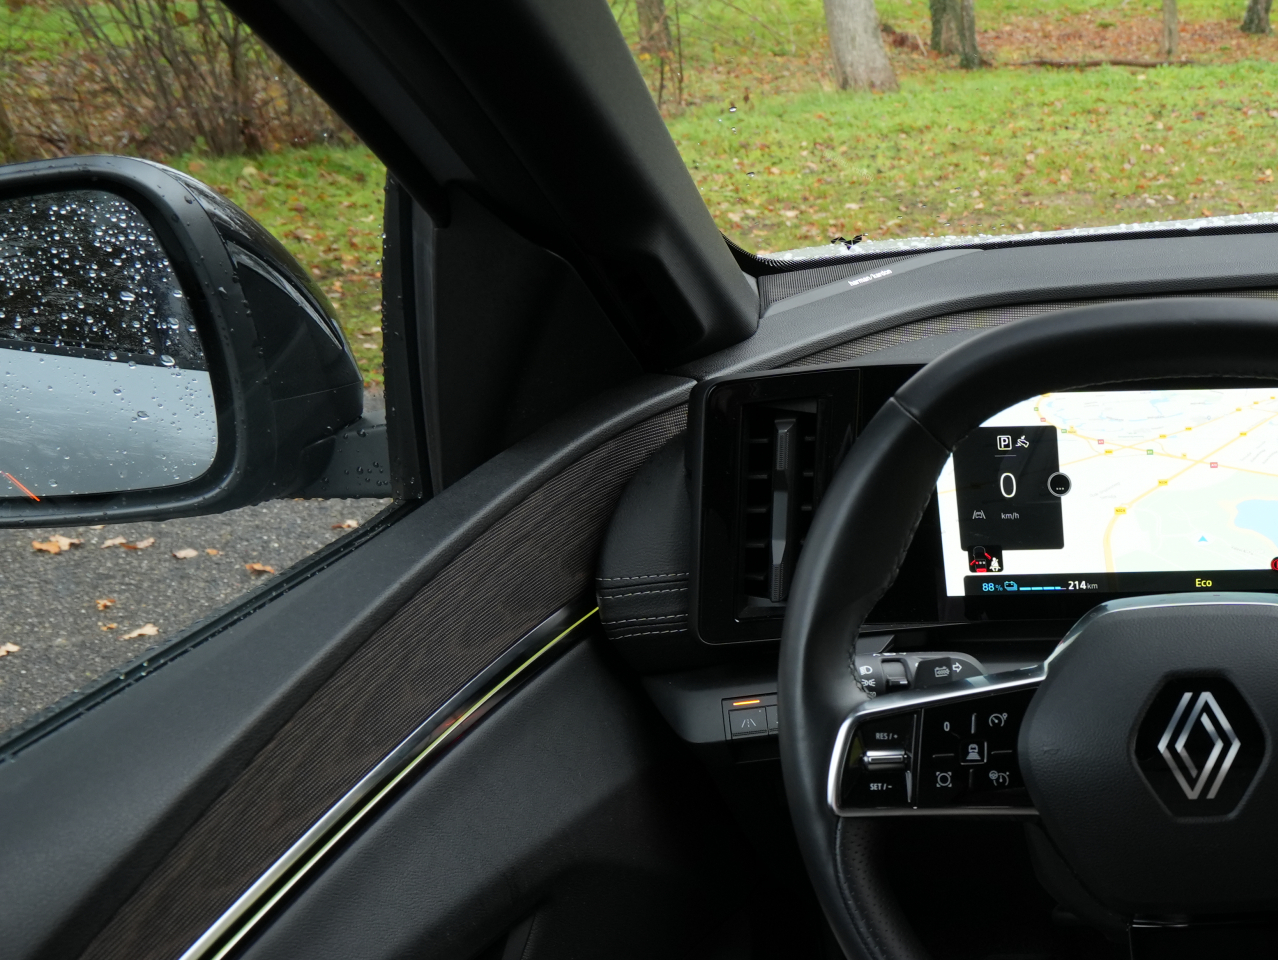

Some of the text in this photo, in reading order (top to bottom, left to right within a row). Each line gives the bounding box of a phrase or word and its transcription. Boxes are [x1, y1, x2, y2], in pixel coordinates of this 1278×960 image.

[1000, 472, 1017, 498] 0
[1001, 512, 1020, 520] km/h
[982, 582, 995, 592] 88
[1068, 581, 1087, 590] 214
[1195, 578, 1213, 588] Eco
